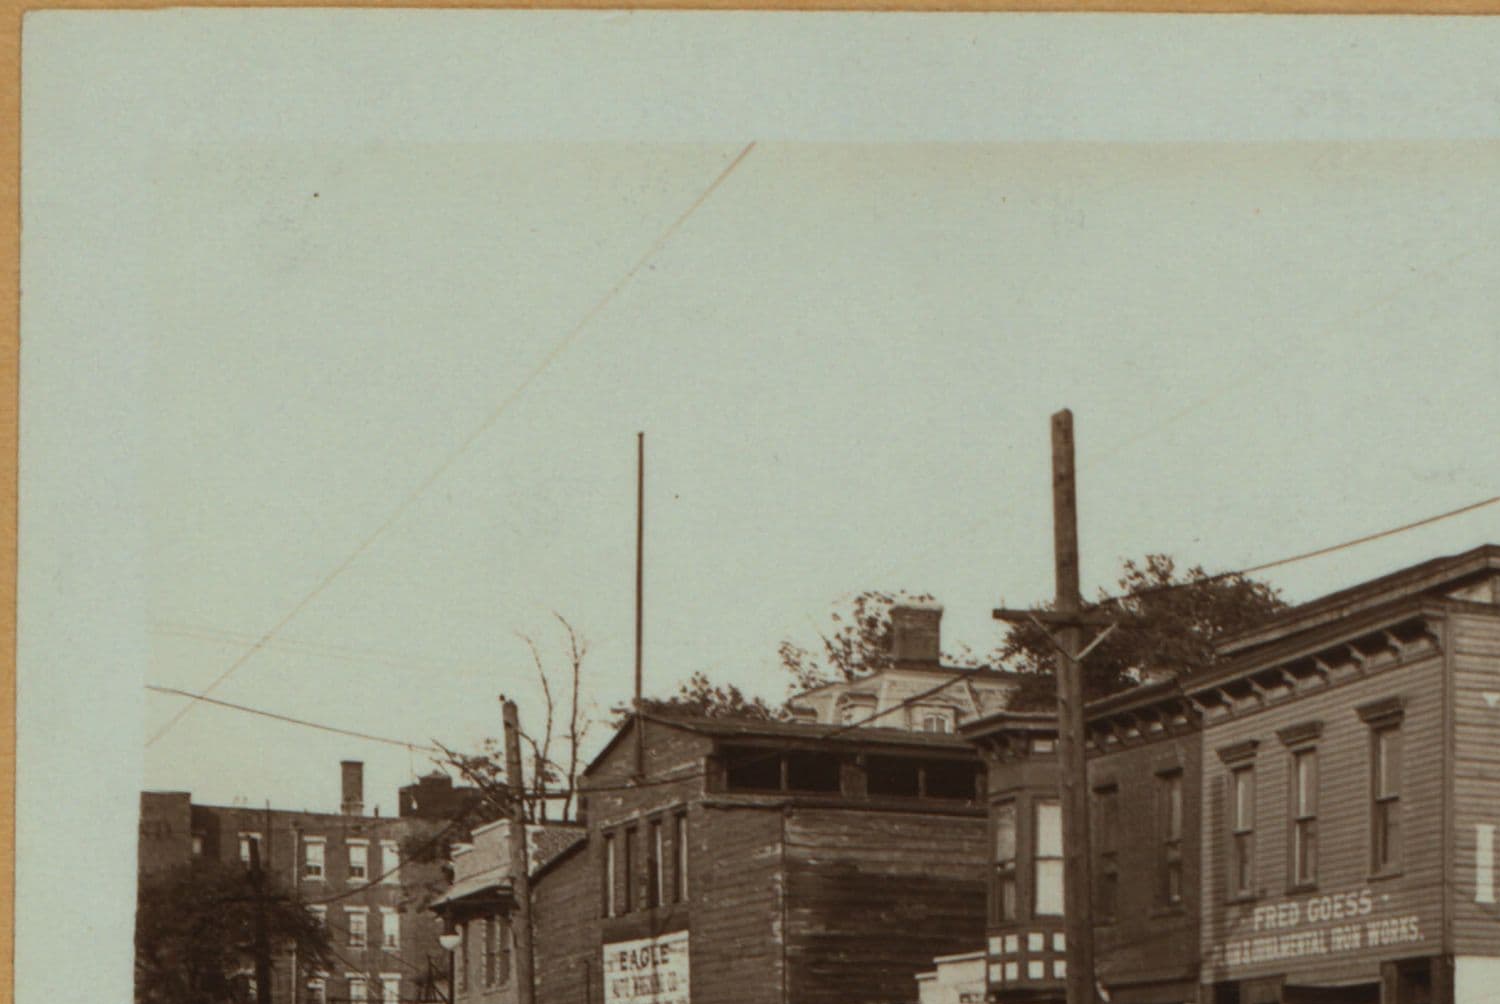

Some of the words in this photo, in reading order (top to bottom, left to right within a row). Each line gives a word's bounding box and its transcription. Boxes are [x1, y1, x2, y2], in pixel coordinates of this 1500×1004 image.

[1253, 901, 1300, 932] FRED
[1307, 888, 1373, 923] GOESS
[619, 943, 670, 972] EAGLE
